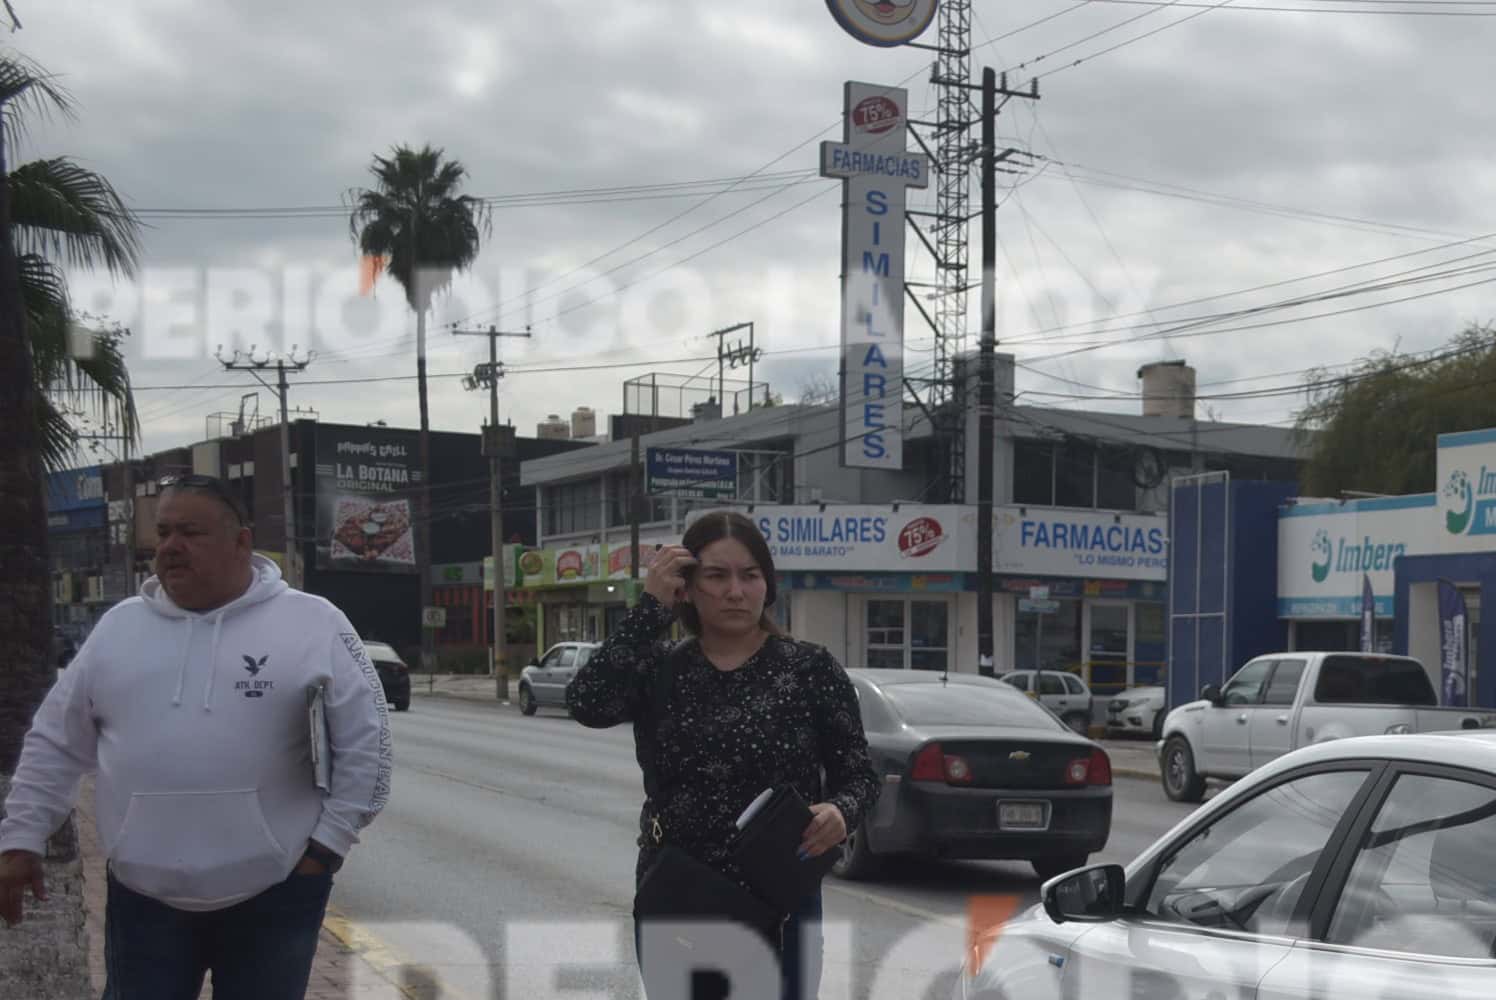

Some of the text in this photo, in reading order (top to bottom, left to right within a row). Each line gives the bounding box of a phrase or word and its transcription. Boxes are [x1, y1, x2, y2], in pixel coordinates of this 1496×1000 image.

[859, 102, 893, 123] 75%
[832, 149, 921, 179] FARMACIAS
[862, 190, 890, 460] SIMILARES
[777, 516, 886, 543] SIMILARES
[903, 525, 936, 548] 75%
[1020, 521, 1163, 554] FARMACIAS
